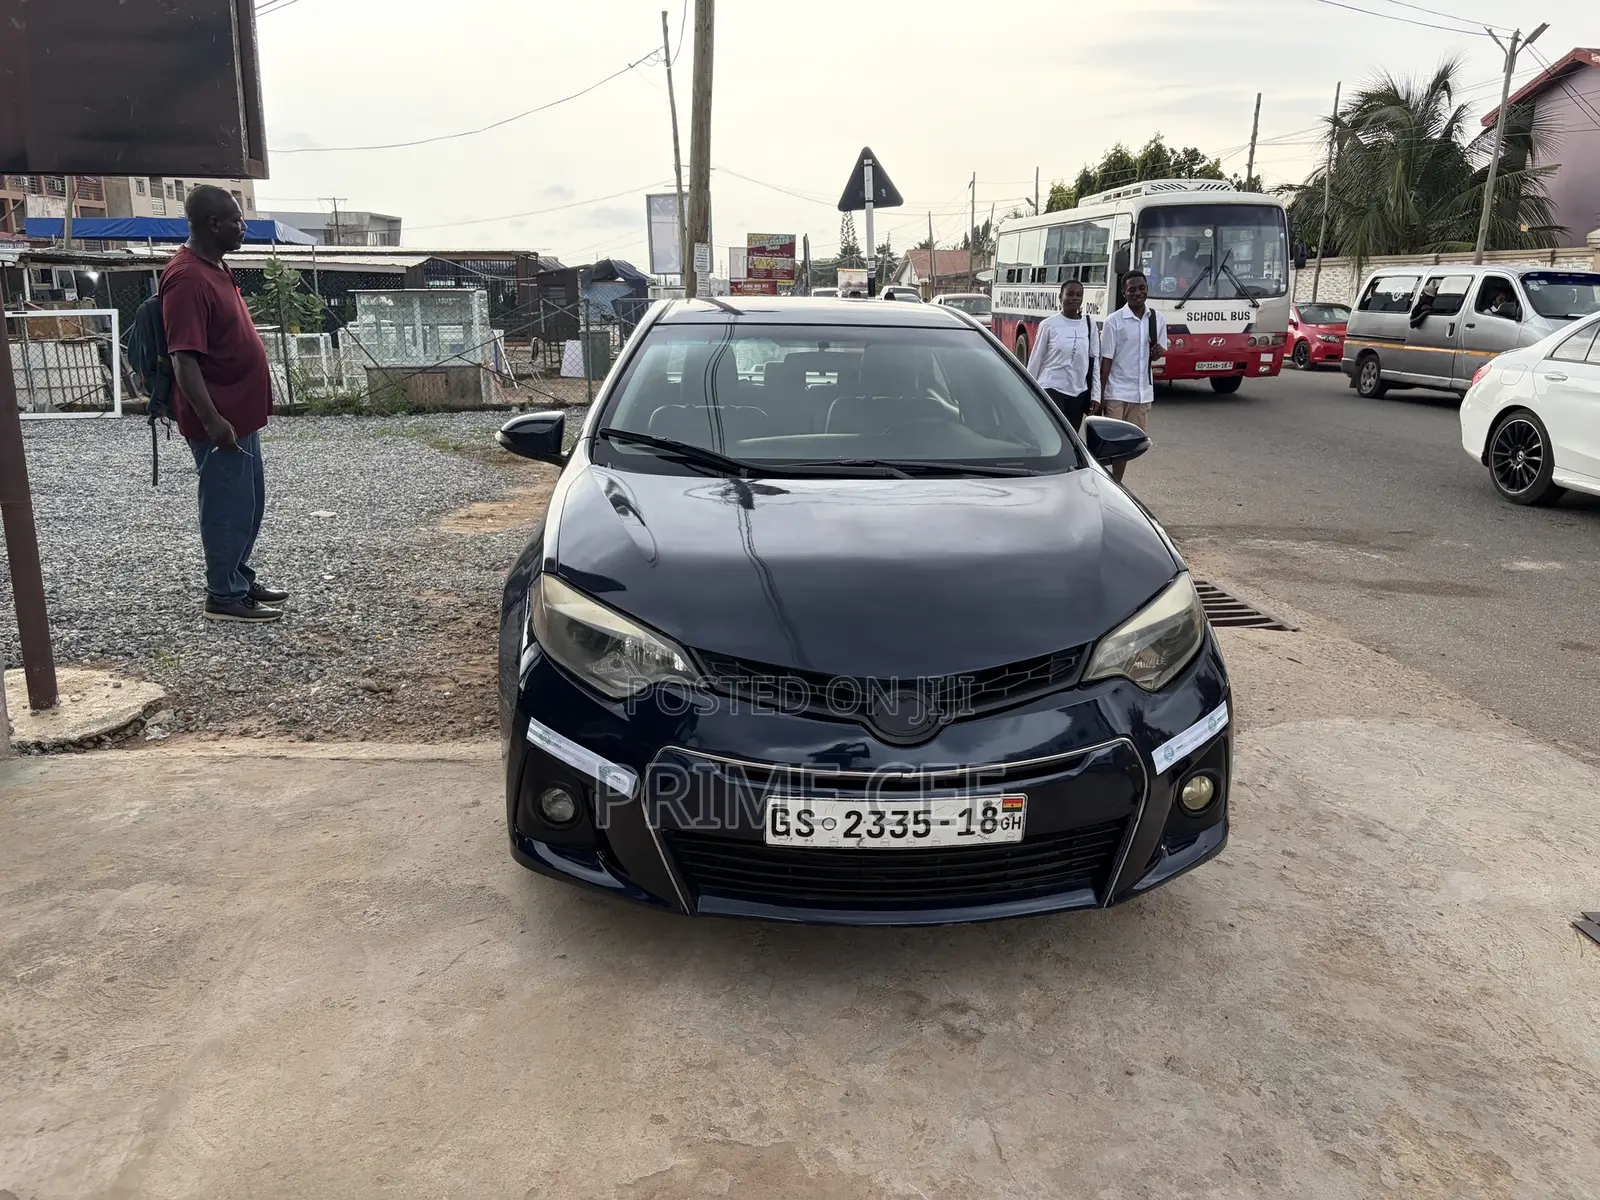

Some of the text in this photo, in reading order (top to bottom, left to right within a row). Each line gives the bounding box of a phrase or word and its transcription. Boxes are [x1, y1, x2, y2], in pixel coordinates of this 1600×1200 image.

[1021, 291, 1058, 311] INTERNATIONAL
[1186, 311, 1251, 322] SCHOOL BUS
[1000, 816, 1022, 832] GH
